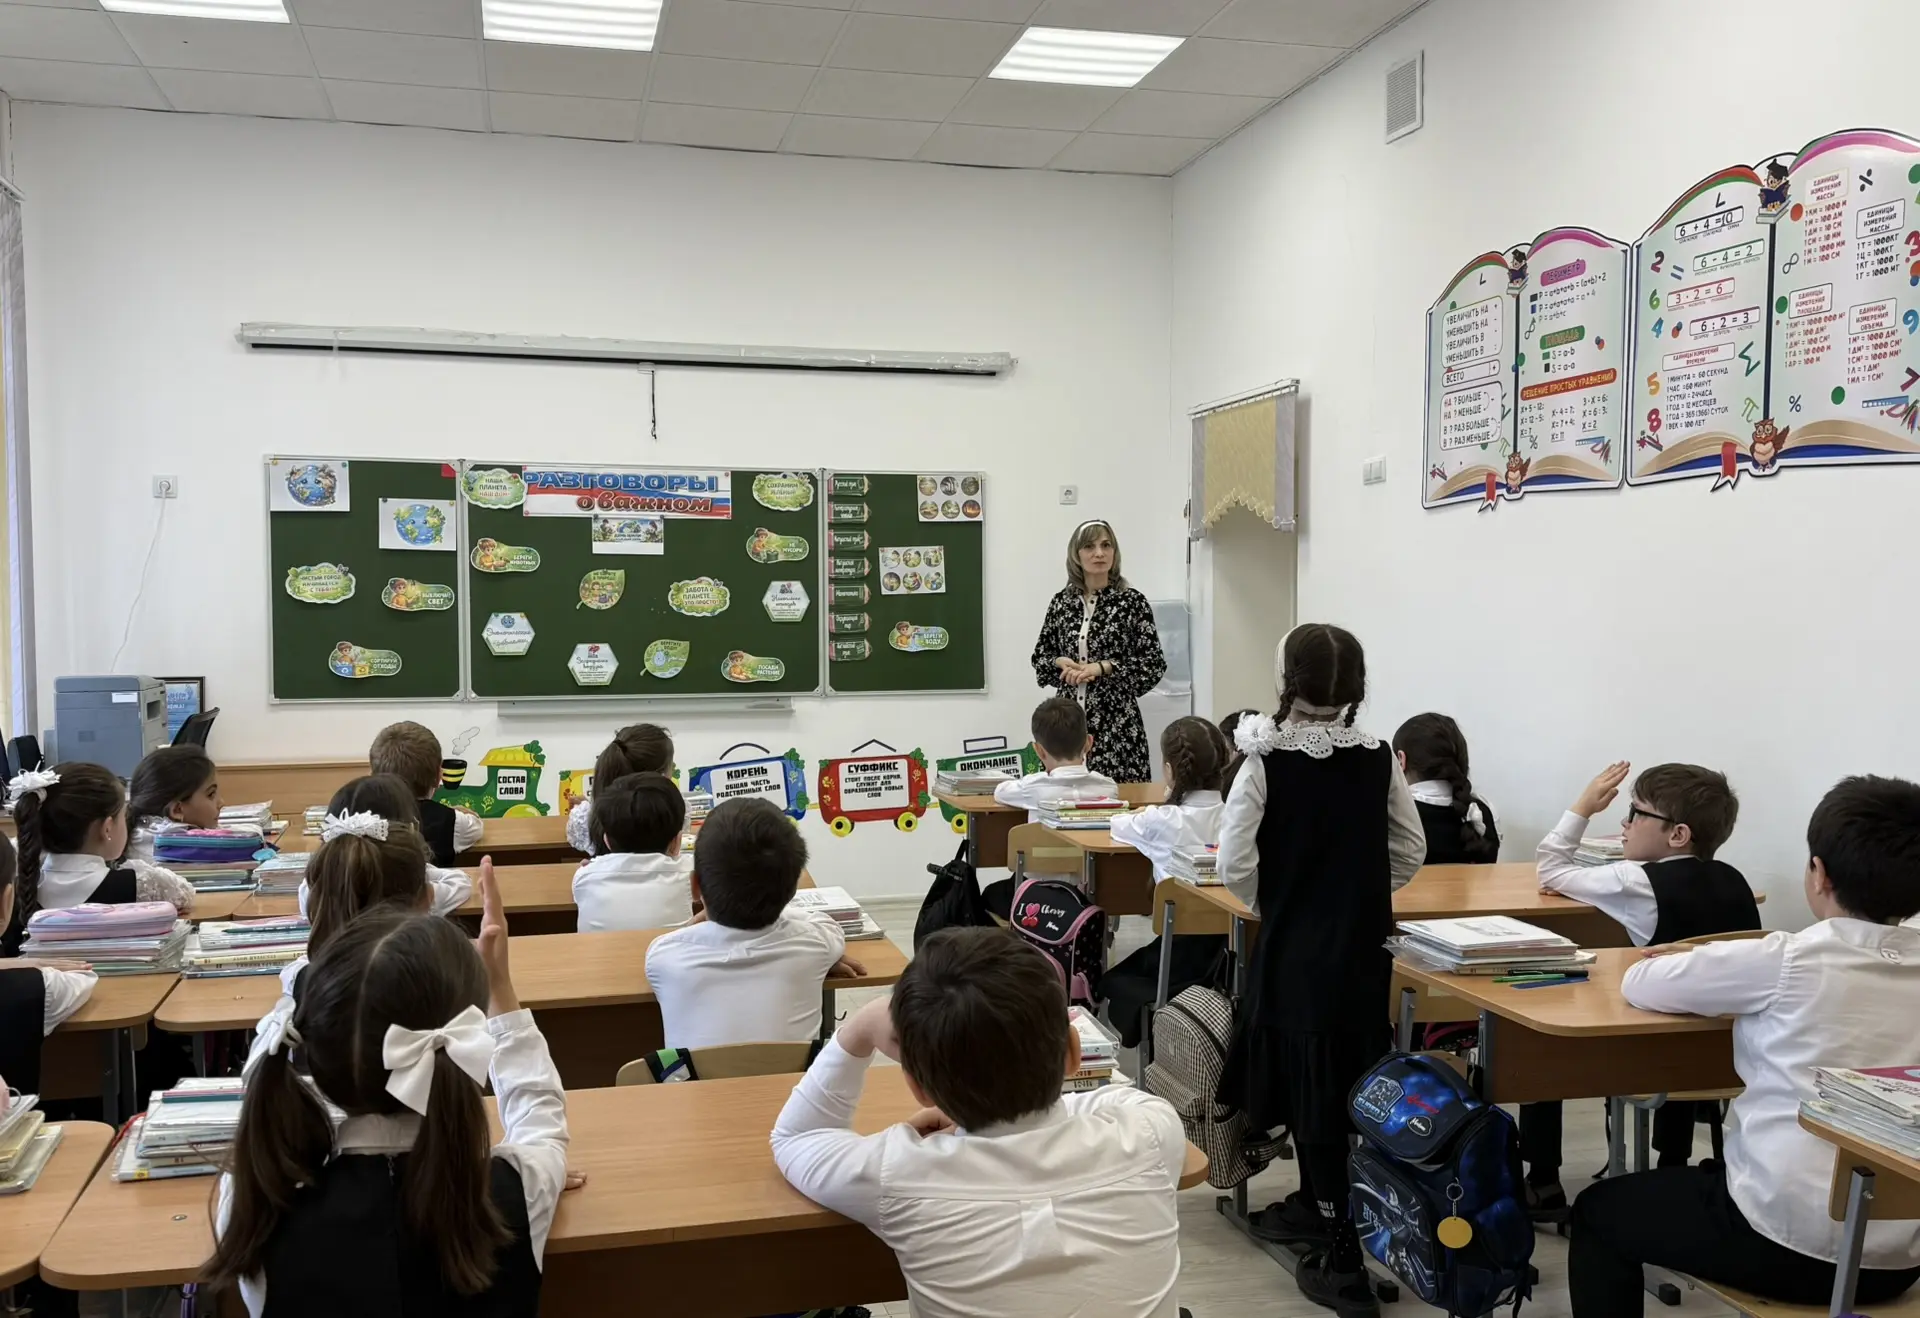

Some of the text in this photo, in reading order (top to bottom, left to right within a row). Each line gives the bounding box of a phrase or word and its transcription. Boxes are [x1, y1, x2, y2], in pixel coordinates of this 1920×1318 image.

[1816, 191, 1835, 201] МАССЫ
[1867, 205, 1895, 218] ЕДИНИЦЫ
[1870, 224, 1890, 233] МАССЫ
[1446, 308, 1479, 325] УВЕЛИЧИТЬ
[1446, 335, 1479, 351] УВЕЛИЧИТЬ
[1550, 380, 1577, 393] ПРОСТЫХ
[523, 471, 718, 492] РАЗГОВОРЫ
[598, 491, 712, 512] важном
[848, 762, 898, 773] СУФФИКС
[960, 756, 1017, 771] ОКОНЧАНИЕ
[727, 767, 768, 780] КОРЕНЬ
[498, 776, 525, 784] СОСТАВ
[725, 779, 770, 790] ОБЩАЯ ЧАСТЬ
[499, 787, 524, 795] СЛОВА
[716, 788, 762, 798] РОДСТВЕННЫХ
[1041, 905, 1066, 917] Cherry
